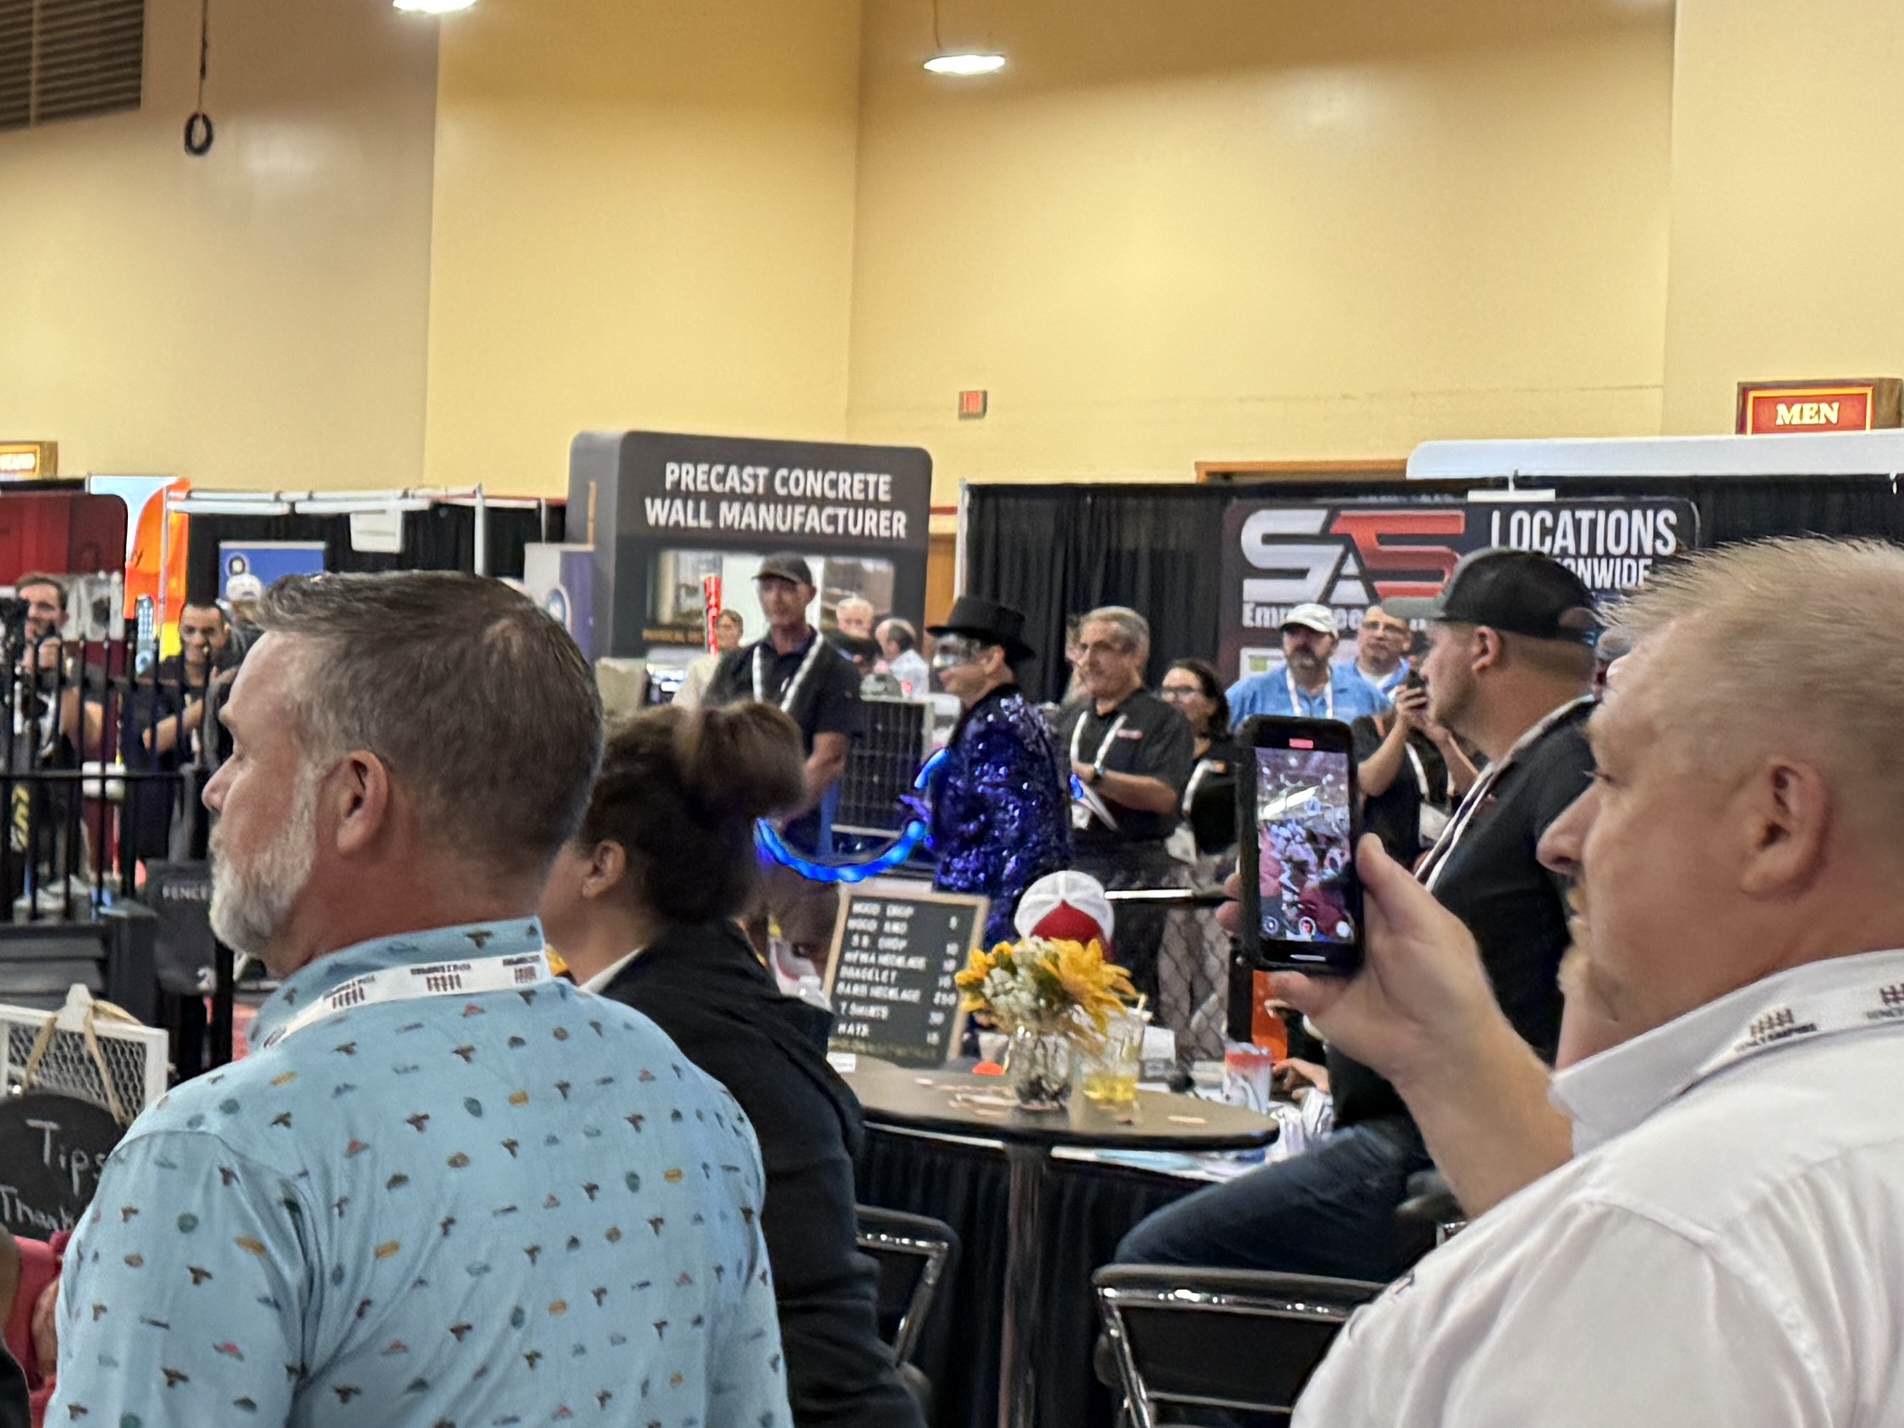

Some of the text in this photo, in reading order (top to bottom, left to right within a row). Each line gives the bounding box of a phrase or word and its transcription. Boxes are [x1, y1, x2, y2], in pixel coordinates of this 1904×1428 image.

[1775, 401, 1840, 426] MEN
[665, 462, 893, 502] PRECAST CONCRETE
[644, 497, 908, 539] WALL MANUFACTURER
[1490, 509, 1678, 557] LOCATIONS
[1558, 557, 1653, 590] ONWIDE
